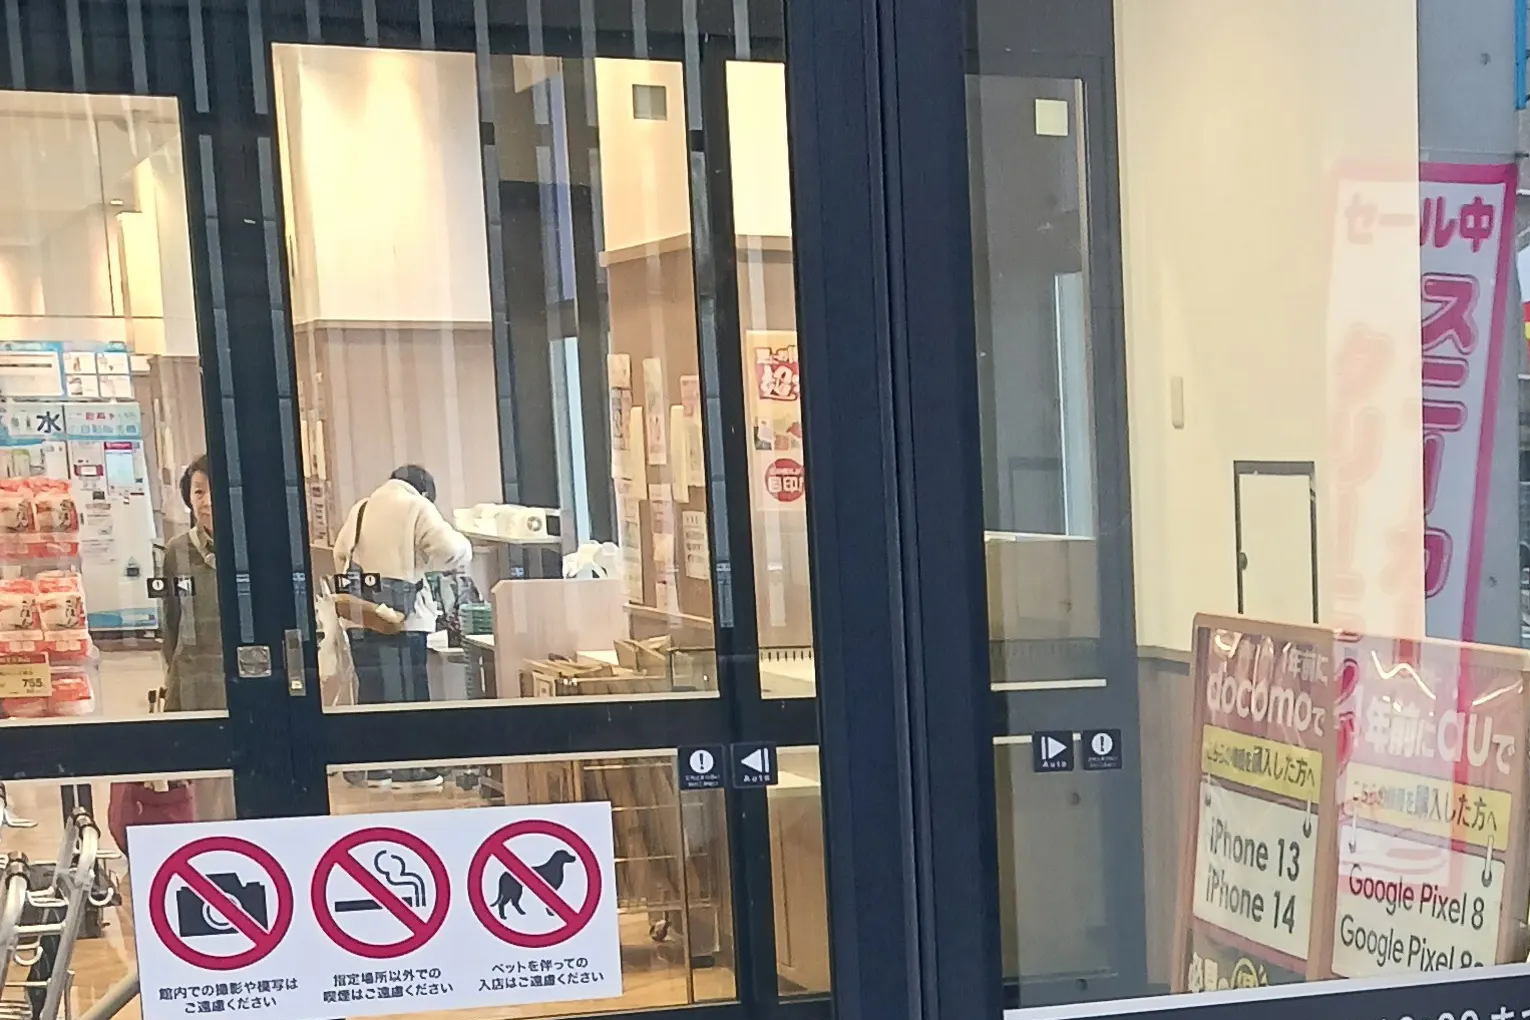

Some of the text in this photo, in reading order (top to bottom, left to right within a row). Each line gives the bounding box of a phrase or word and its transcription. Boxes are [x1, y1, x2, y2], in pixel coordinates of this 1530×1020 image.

[36, 411, 62, 434] 水
[1209, 816, 1300, 882] iPhone 13
[1205, 863, 1297, 935] iPhone 14
[1348, 862, 1486, 931] Google Pixel 8
[1339, 913, 1405, 967] Google
[1407, 934, 1455, 972] Pixel
[491, 957, 589, 974] ペットを伴っての
[333, 967, 442, 987] 指定場所以外での
[478, 971, 604, 992] 入店はご遠慮ください
[322, 982, 454, 1004] 喫煙はご遠慮ください
[184, 996, 277, 1014] ご遠慮ください
